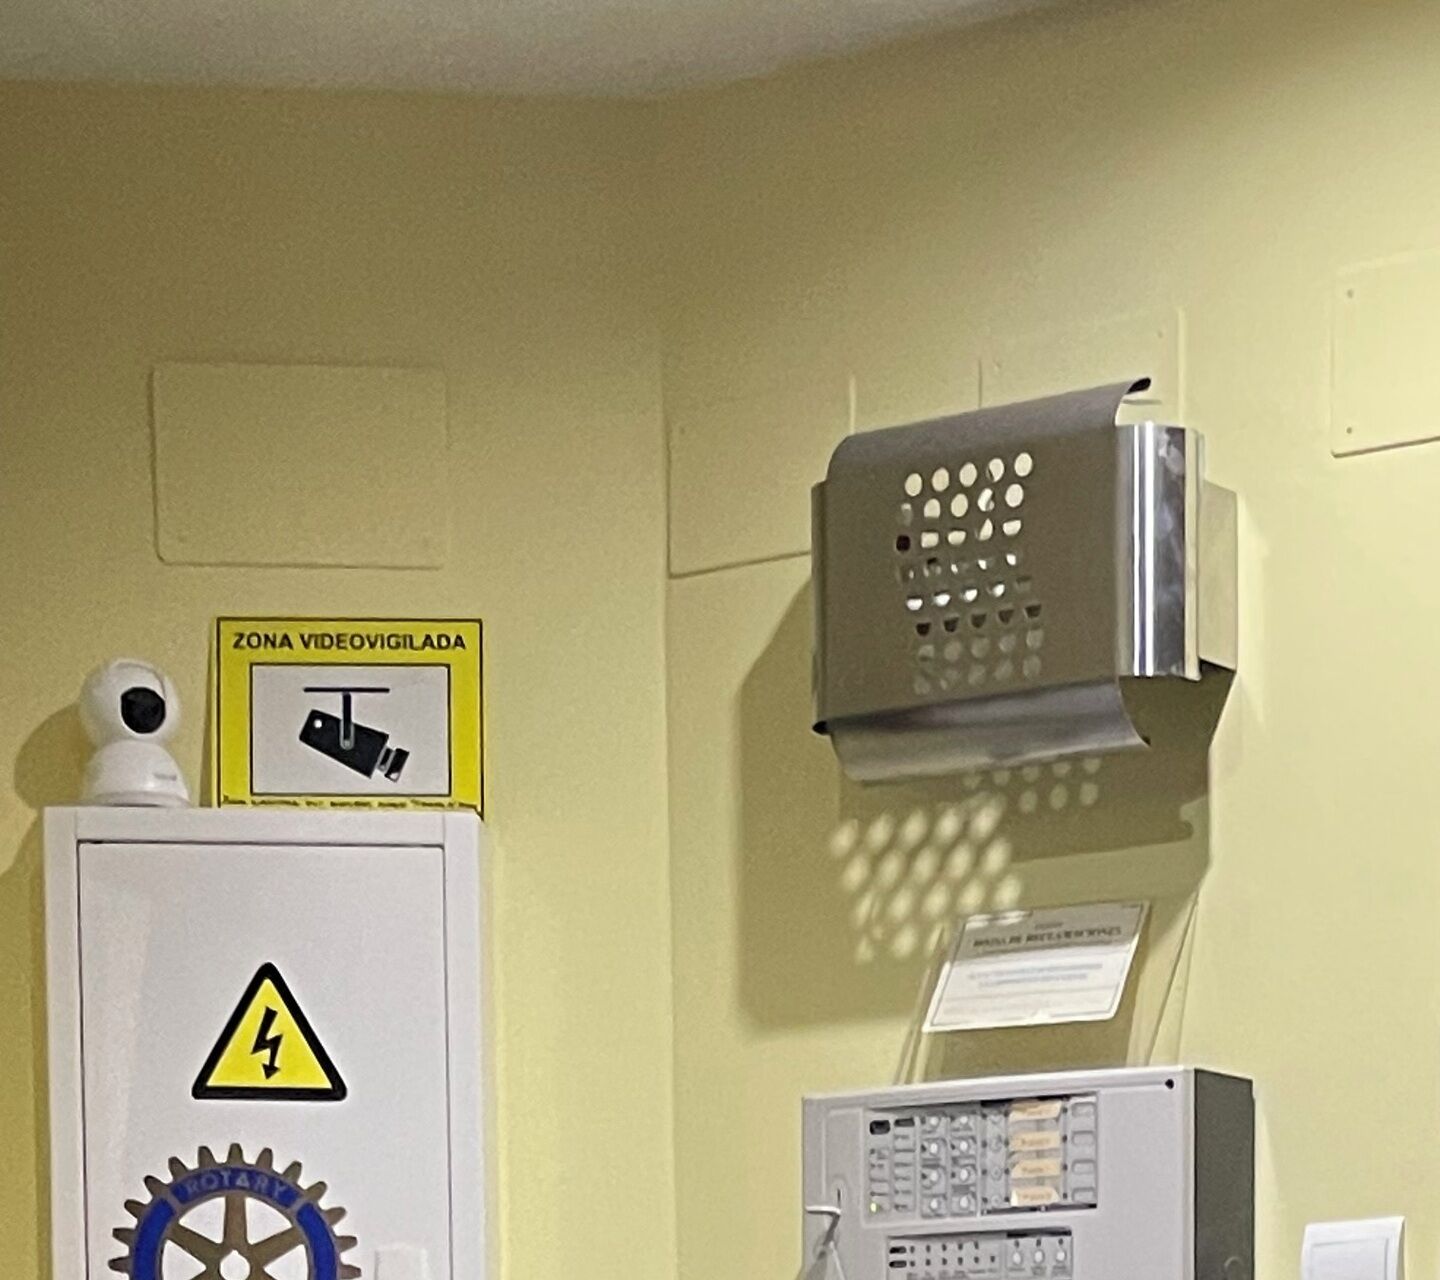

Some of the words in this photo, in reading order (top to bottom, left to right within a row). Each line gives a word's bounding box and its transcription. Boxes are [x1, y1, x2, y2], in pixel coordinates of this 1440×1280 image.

[233, 632, 294, 651] ZONA
[299, 632, 467, 651] VIDEOVIGILADA
[184, 1169, 289, 1196] ROTARY
